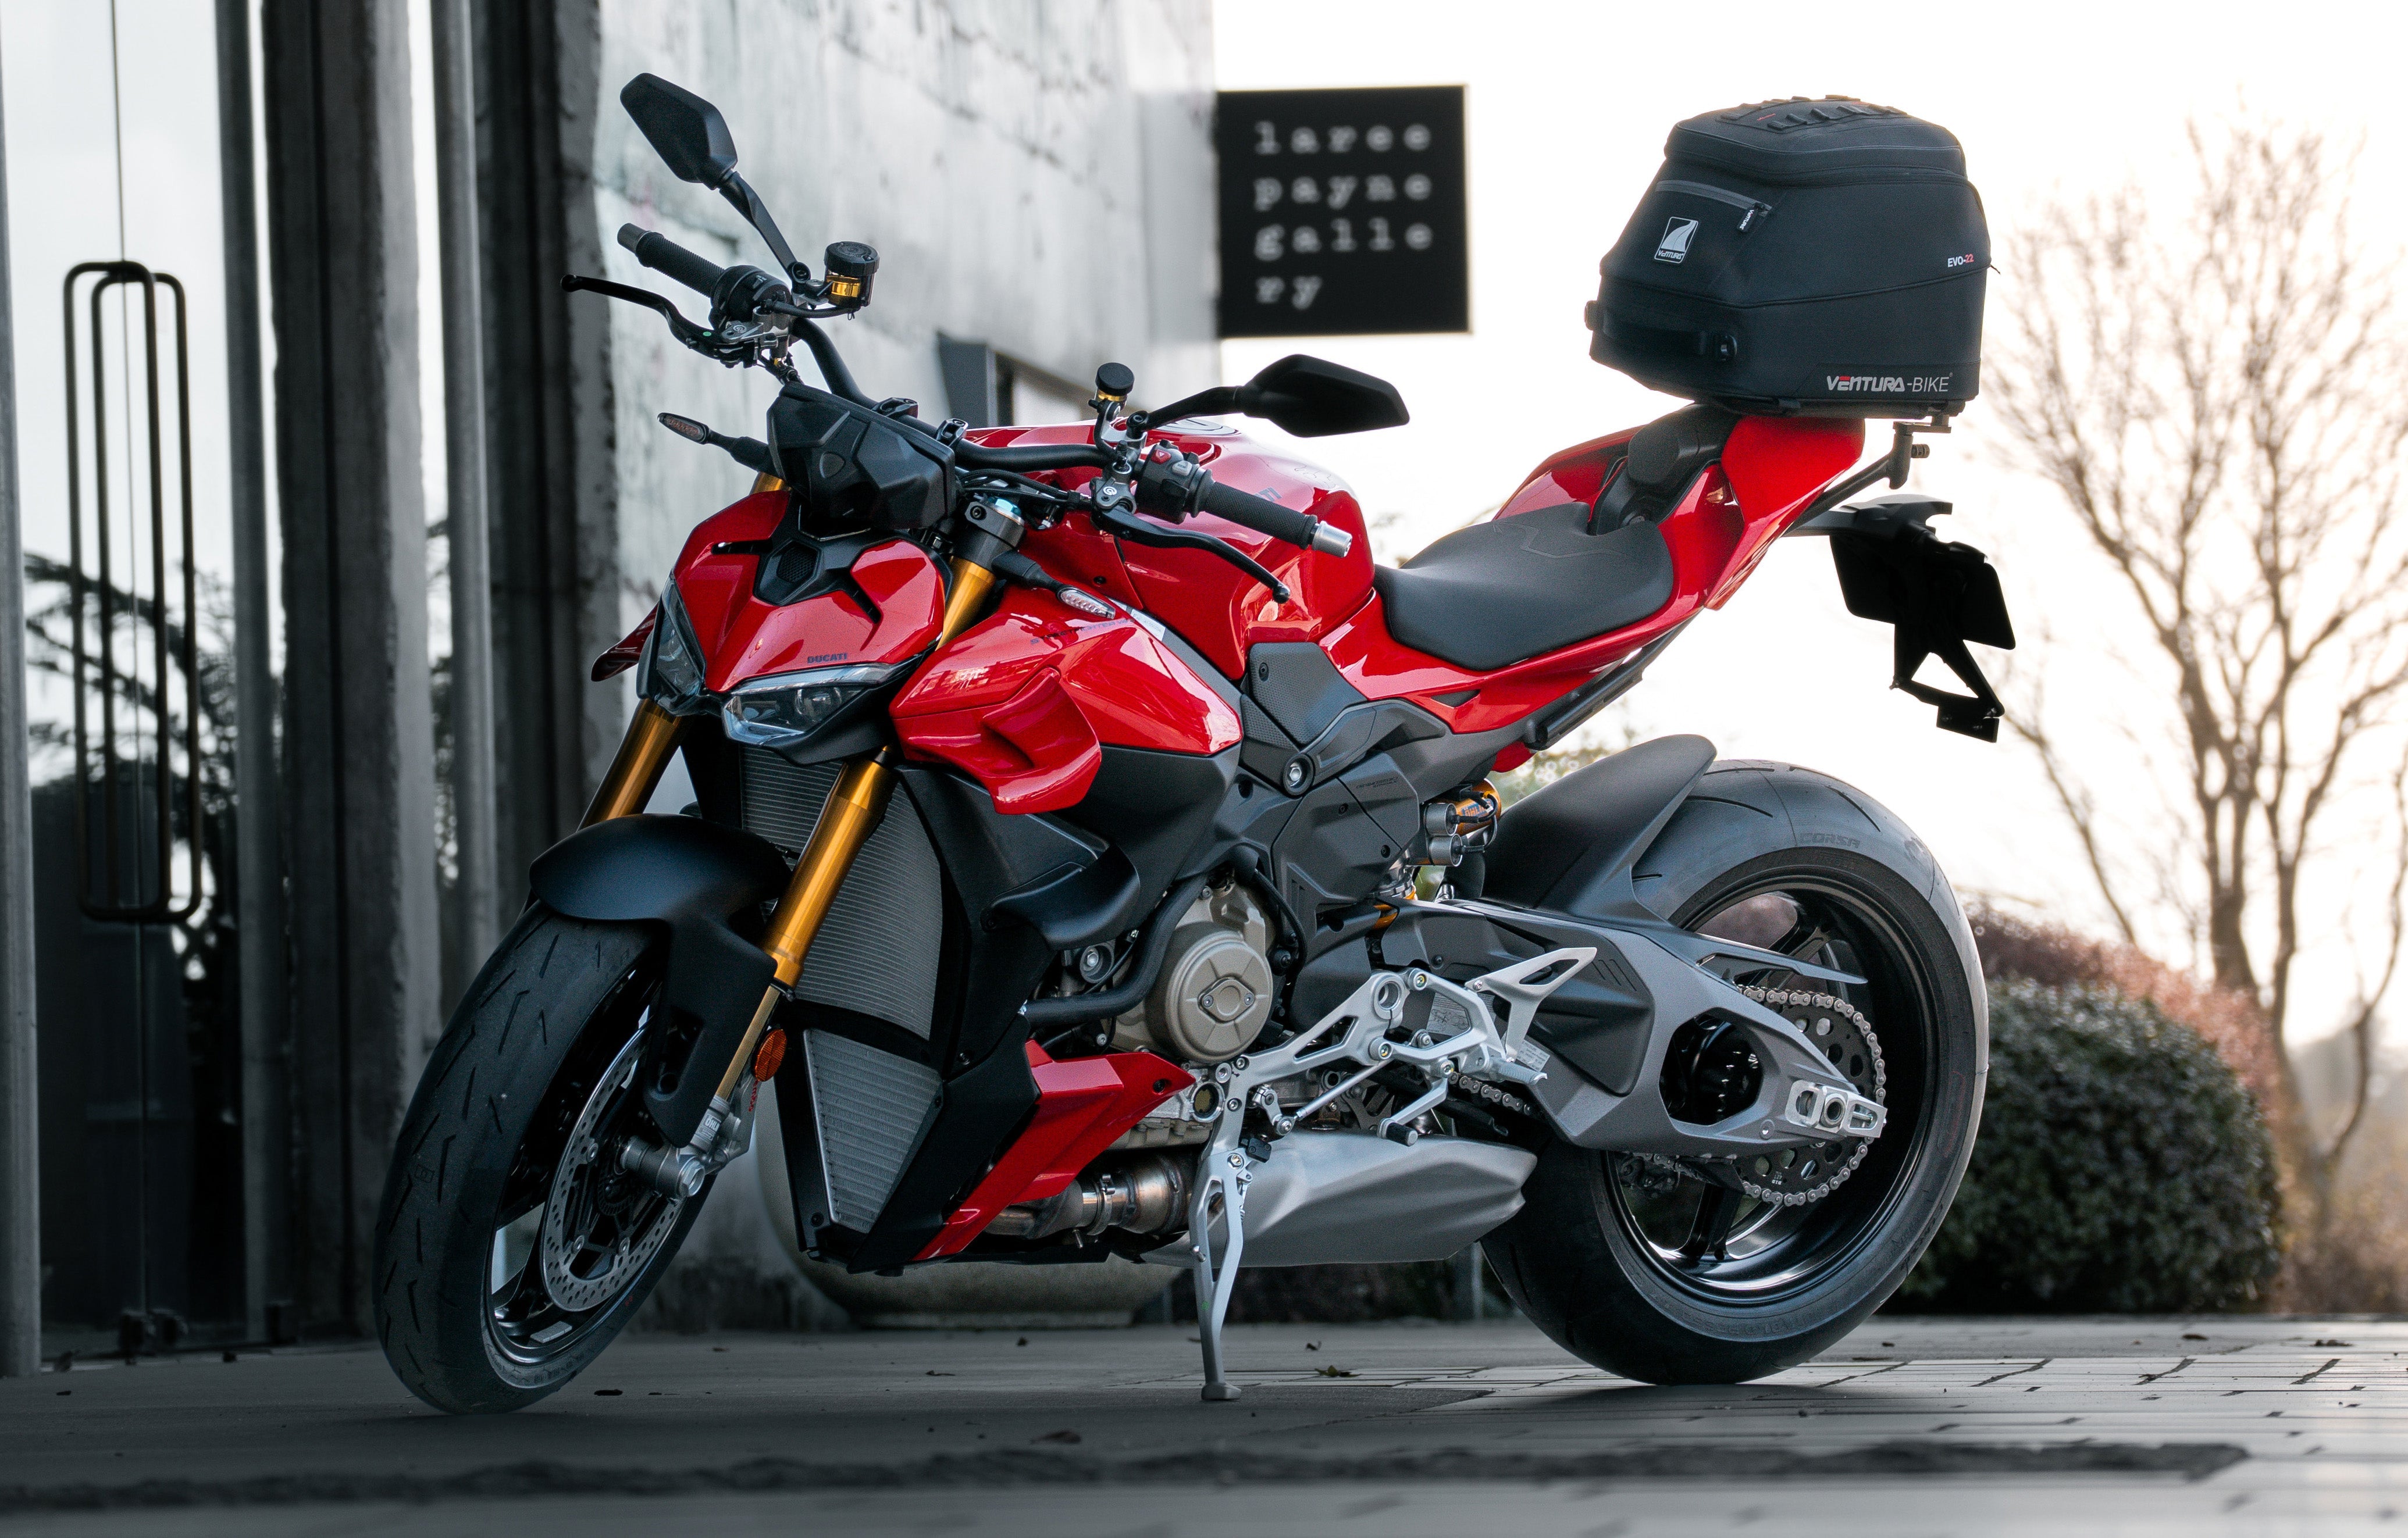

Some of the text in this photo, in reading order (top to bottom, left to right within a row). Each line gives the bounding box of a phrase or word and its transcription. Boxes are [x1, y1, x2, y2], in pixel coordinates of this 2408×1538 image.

[1253, 173, 1432, 212] payne
[1947, 254, 1974, 267] EVO-22
[1256, 276, 1323, 310] ry
[807, 652, 847, 663] DUCATI
[1800, 833, 1861, 849] CORSA
